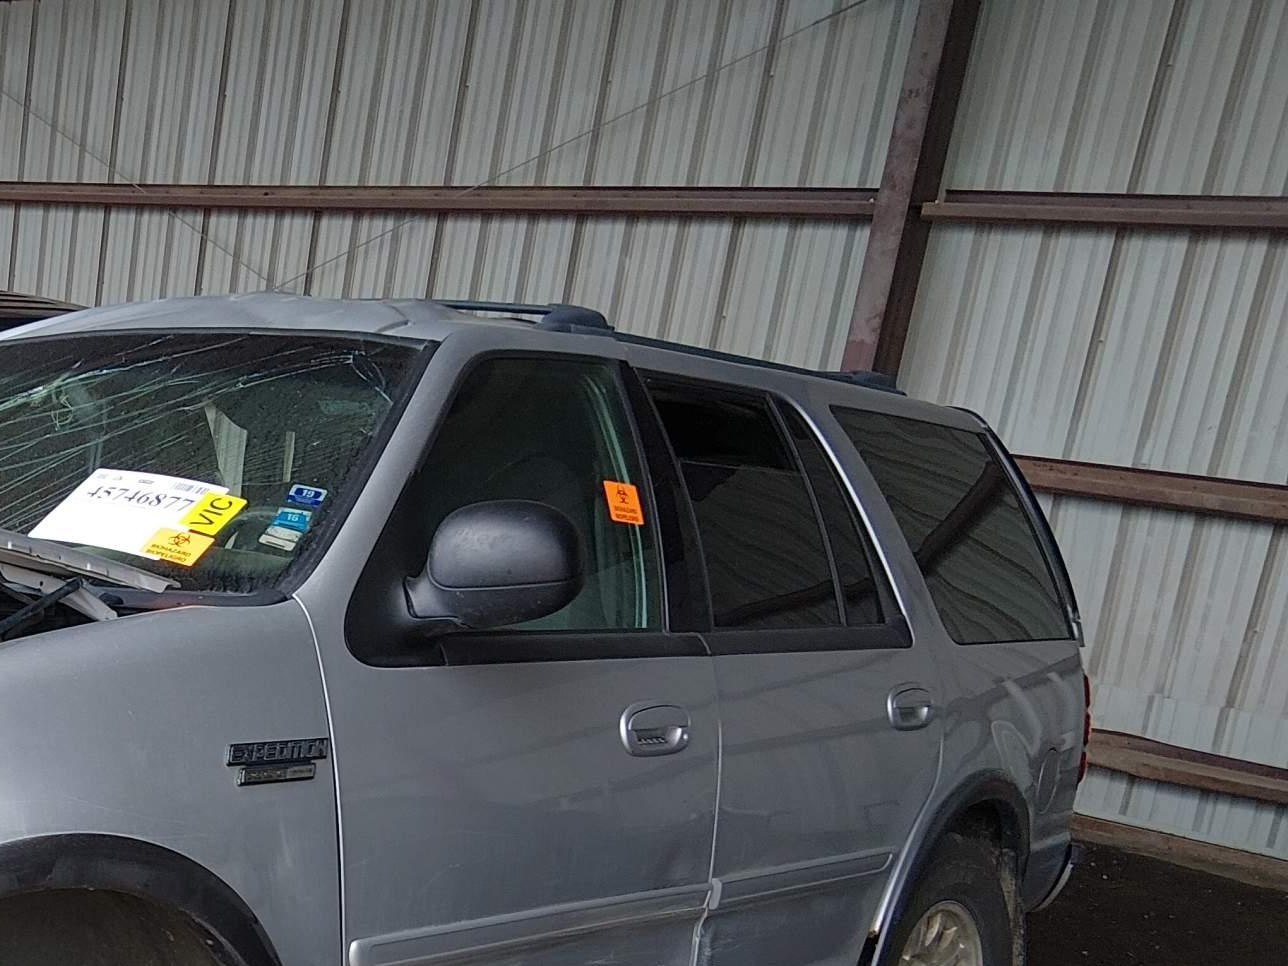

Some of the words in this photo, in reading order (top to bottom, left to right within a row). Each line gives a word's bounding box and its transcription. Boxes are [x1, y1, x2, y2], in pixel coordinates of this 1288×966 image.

[87, 485, 197, 512] 45746877
[189, 497, 233, 527] VIC
[230, 739, 327, 763] EXPEDITION
